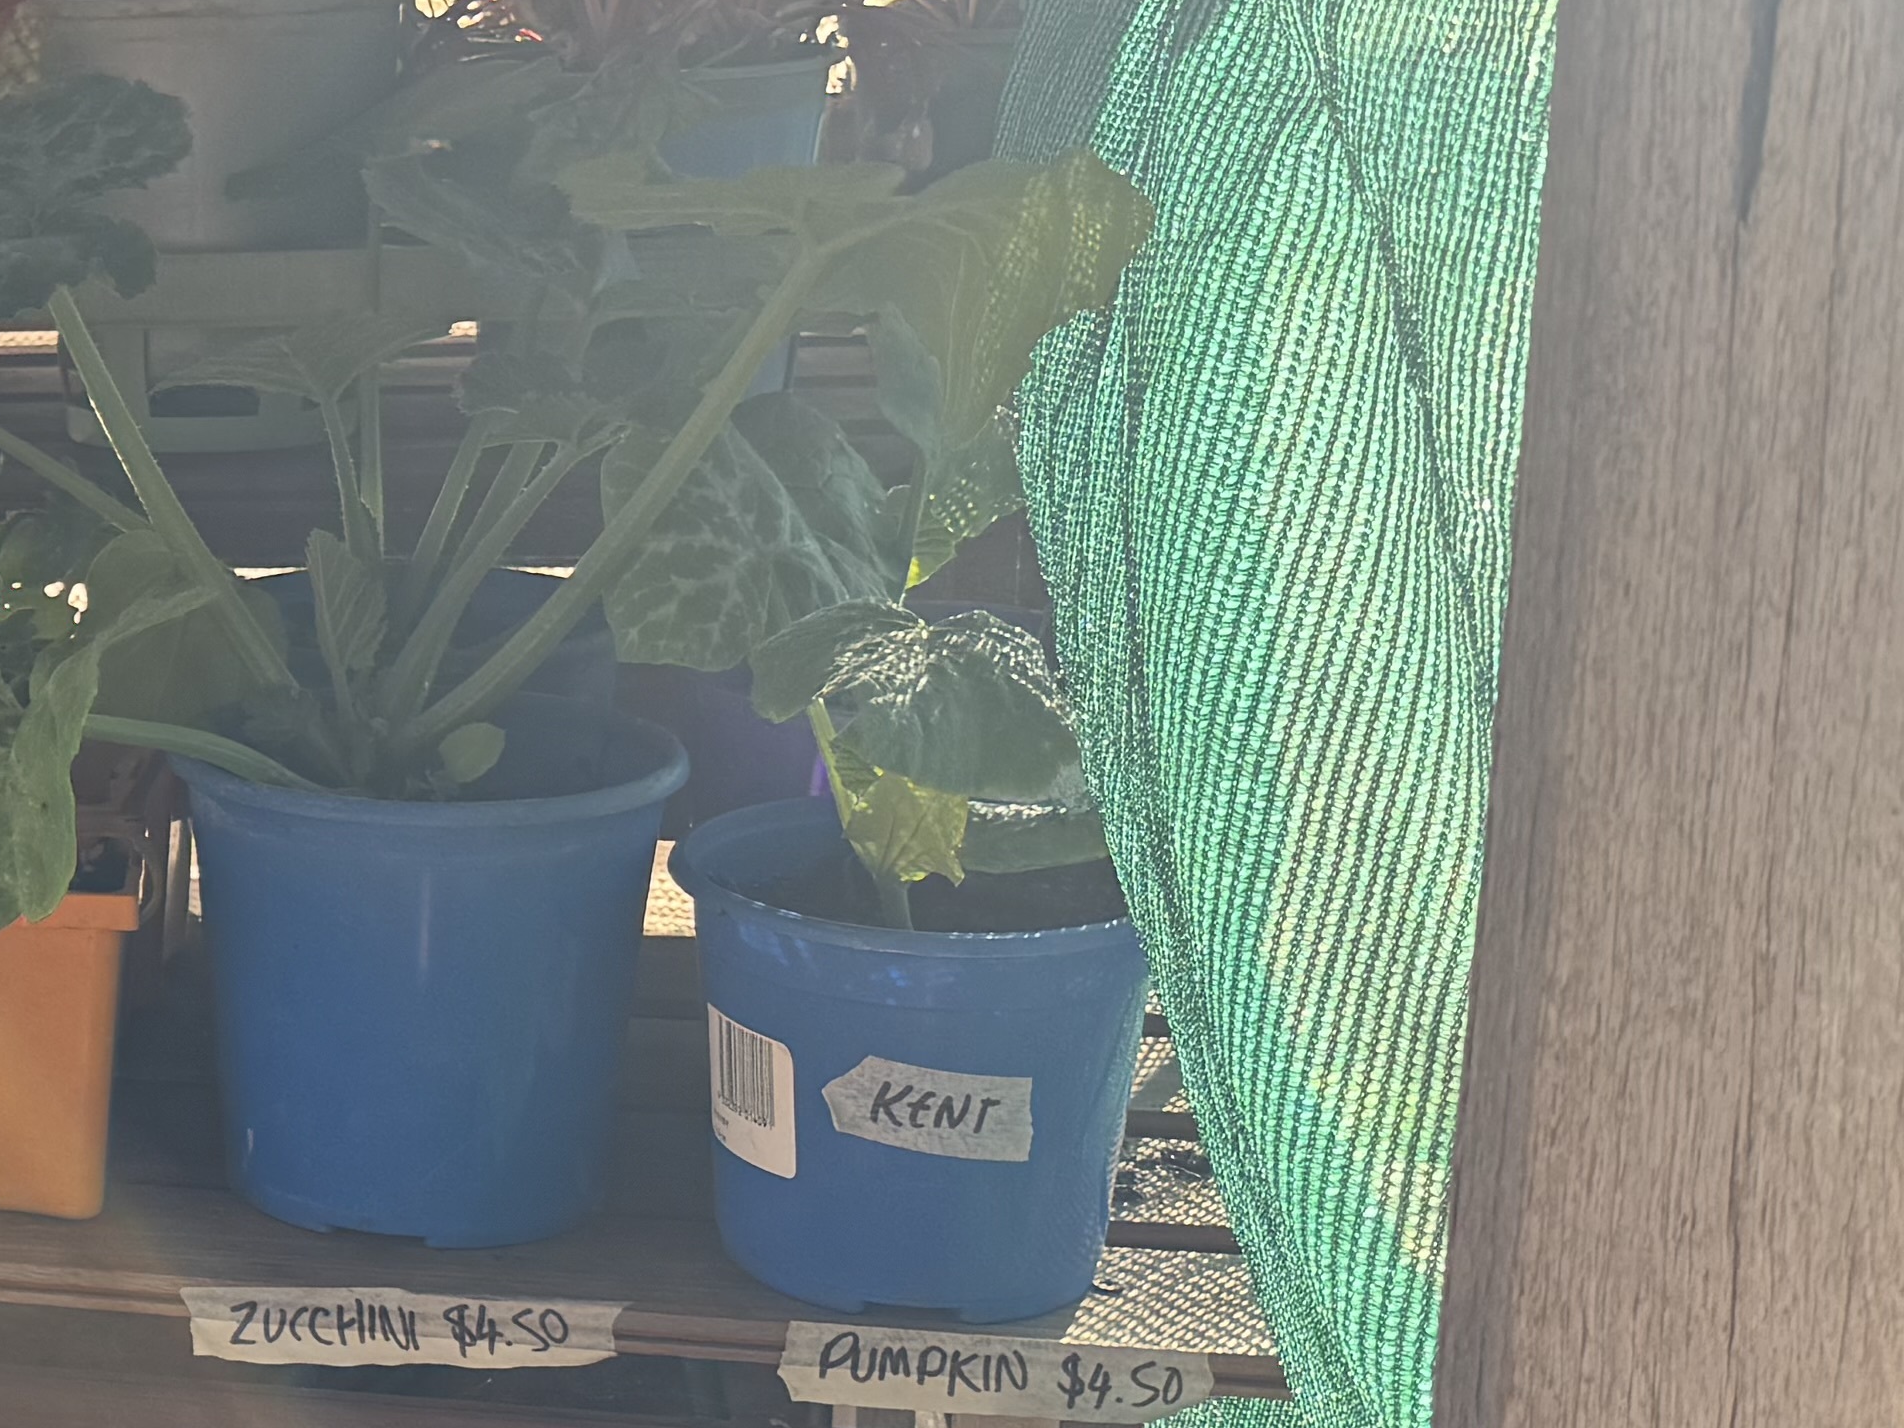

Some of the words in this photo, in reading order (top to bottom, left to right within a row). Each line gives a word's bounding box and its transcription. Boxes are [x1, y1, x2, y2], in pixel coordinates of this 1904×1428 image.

[870, 1081, 1000, 1135] KENT
[229, 1297, 421, 1351] ZUCCHINI
[443, 1303, 570, 1358] $4.50
[819, 1331, 1030, 1398] PUMPKIN
[1058, 1352, 1184, 1410] $4.50
